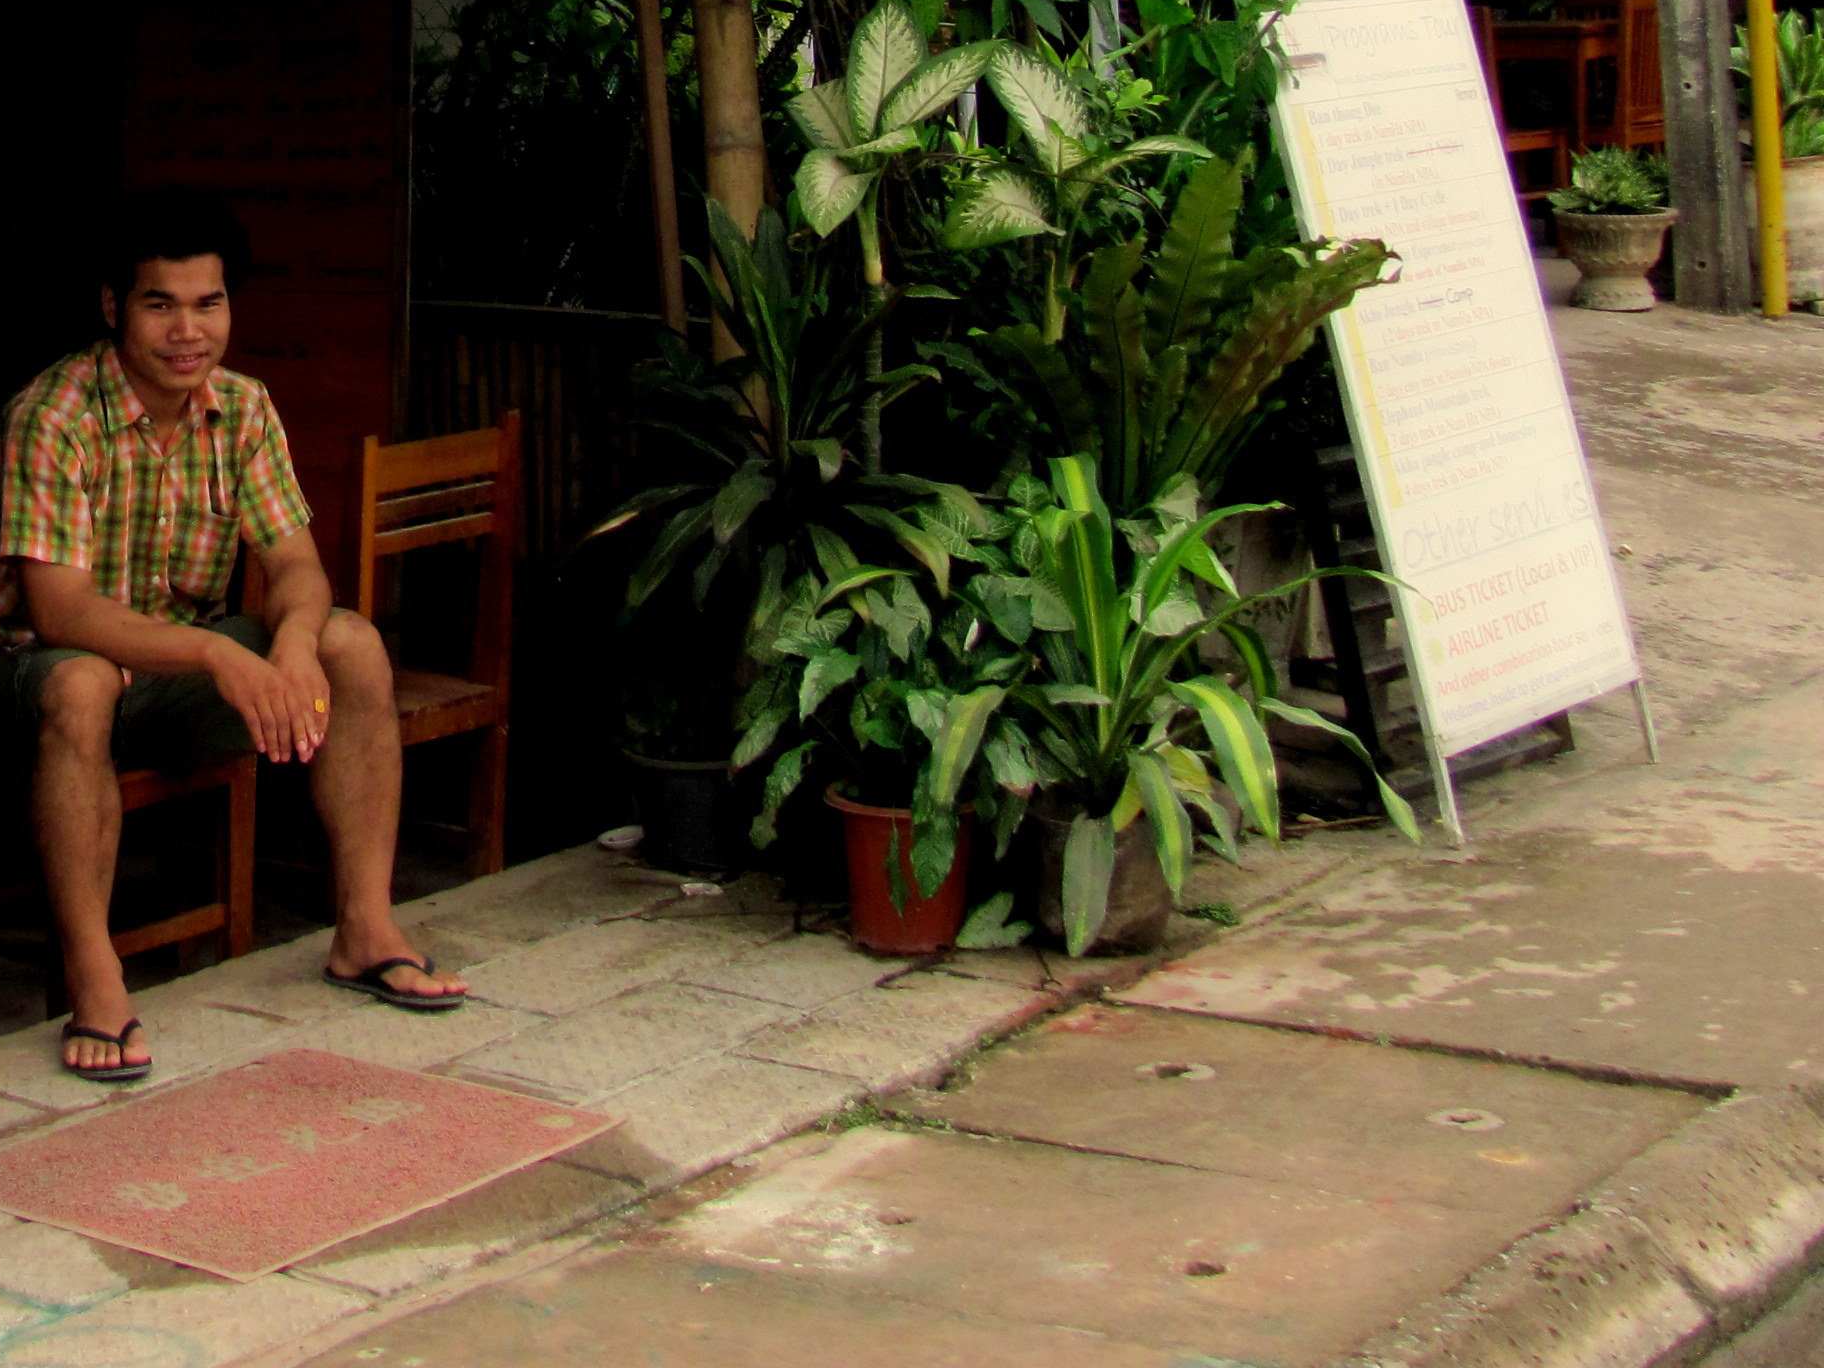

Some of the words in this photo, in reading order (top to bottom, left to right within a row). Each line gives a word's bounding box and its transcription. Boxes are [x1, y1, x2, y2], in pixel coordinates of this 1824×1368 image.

[1435, 587, 1466, 618] BUS
[1466, 570, 1513, 605] TICKET
[1448, 619, 1502, 657] AIRLINE
[1502, 601, 1548, 635] TICKET
[1461, 667, 1489, 689] other
